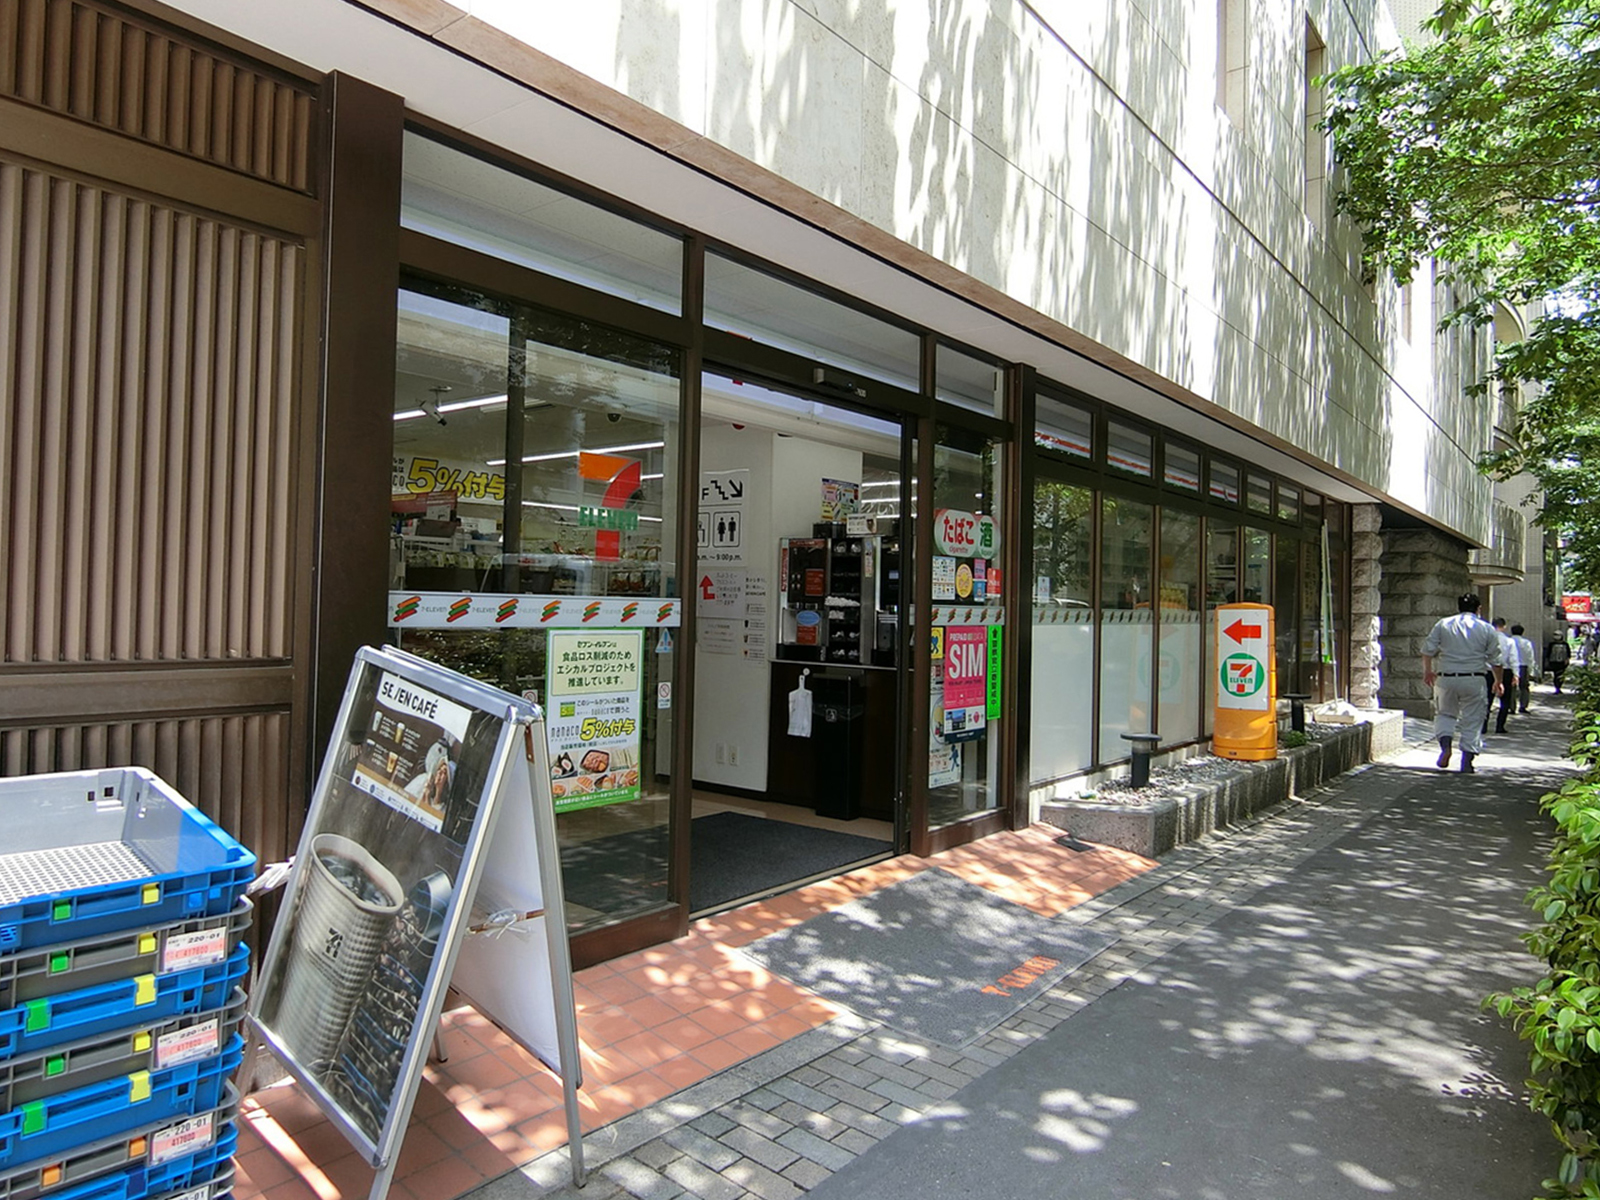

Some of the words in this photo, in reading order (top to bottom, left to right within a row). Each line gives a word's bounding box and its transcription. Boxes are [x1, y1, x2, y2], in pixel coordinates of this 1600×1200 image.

[579, 452, 641, 562] 7
[943, 515, 974, 545] たばこ
[980, 521, 993, 548] 酒
[557, 662, 636, 675] エシカルプロジェクトを
[562, 651, 632, 662] 食品ロス削減のため
[948, 643, 984, 679] SIM
[1230, 663, 1253, 693] 7
[411, 699, 438, 719] CAFÉ
[175, 1117, 207, 1136] 220-01
